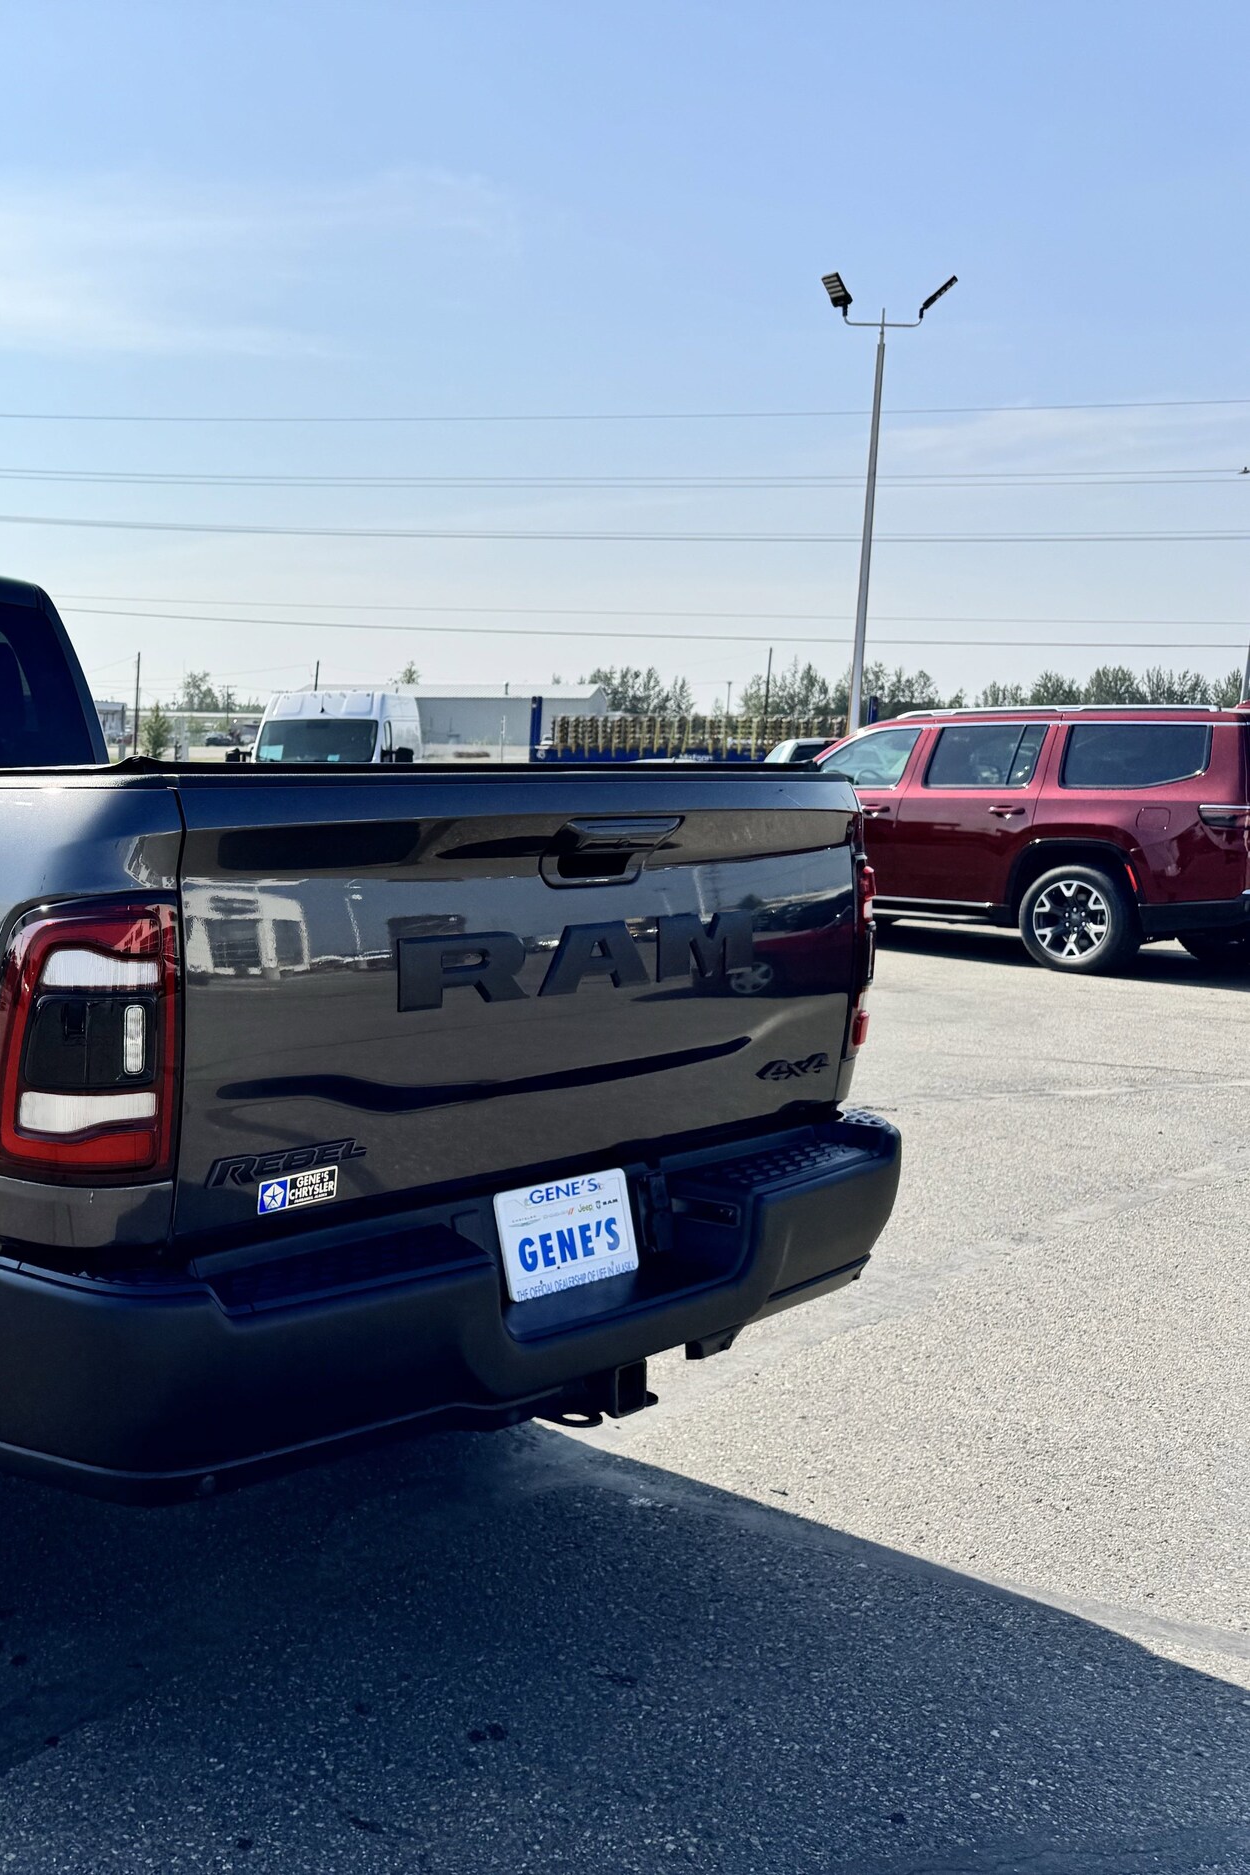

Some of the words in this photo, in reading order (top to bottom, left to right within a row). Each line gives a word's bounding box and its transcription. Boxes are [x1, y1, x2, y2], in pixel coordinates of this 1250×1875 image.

[397, 909, 754, 1012] RAM
[204, 1137, 368, 1189] REBEL
[296, 1171, 329, 1188] GENE'S
[289, 1180, 335, 1200] CHRYSLER
[529, 1177, 599, 1205] GENE'S
[518, 1217, 621, 1272] GENE'S
[516, 1290, 529, 1302] THE
[530, 1281, 554, 1298] OFFICIAL
[554, 1273, 587, 1292] DEALERSHIP
[587, 1270, 596, 1282] OF
[596, 1267, 607, 1280] LIFE
